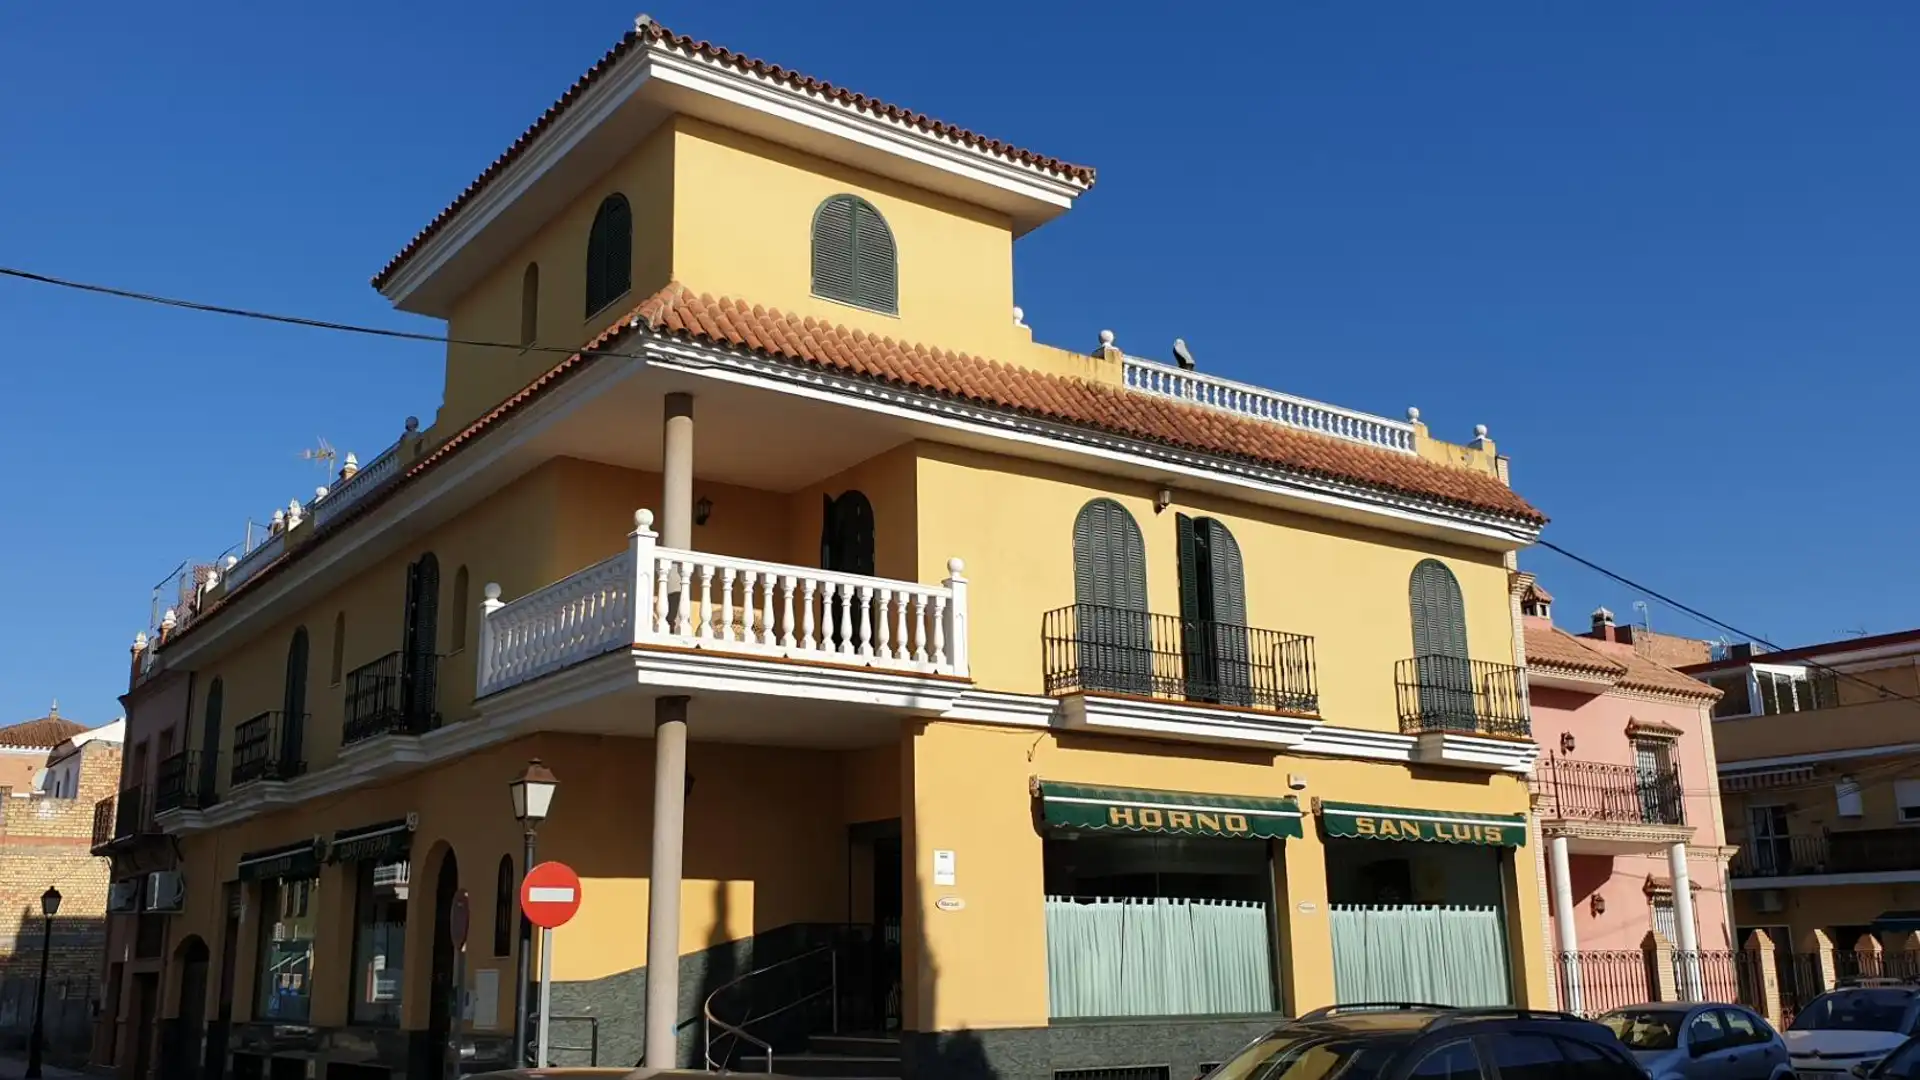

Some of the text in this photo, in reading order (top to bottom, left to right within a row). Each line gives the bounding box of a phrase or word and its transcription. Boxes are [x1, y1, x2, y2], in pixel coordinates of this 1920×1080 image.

[1108, 807, 1249, 832] HORNO
[1355, 816, 1502, 842] SAN LUIS
